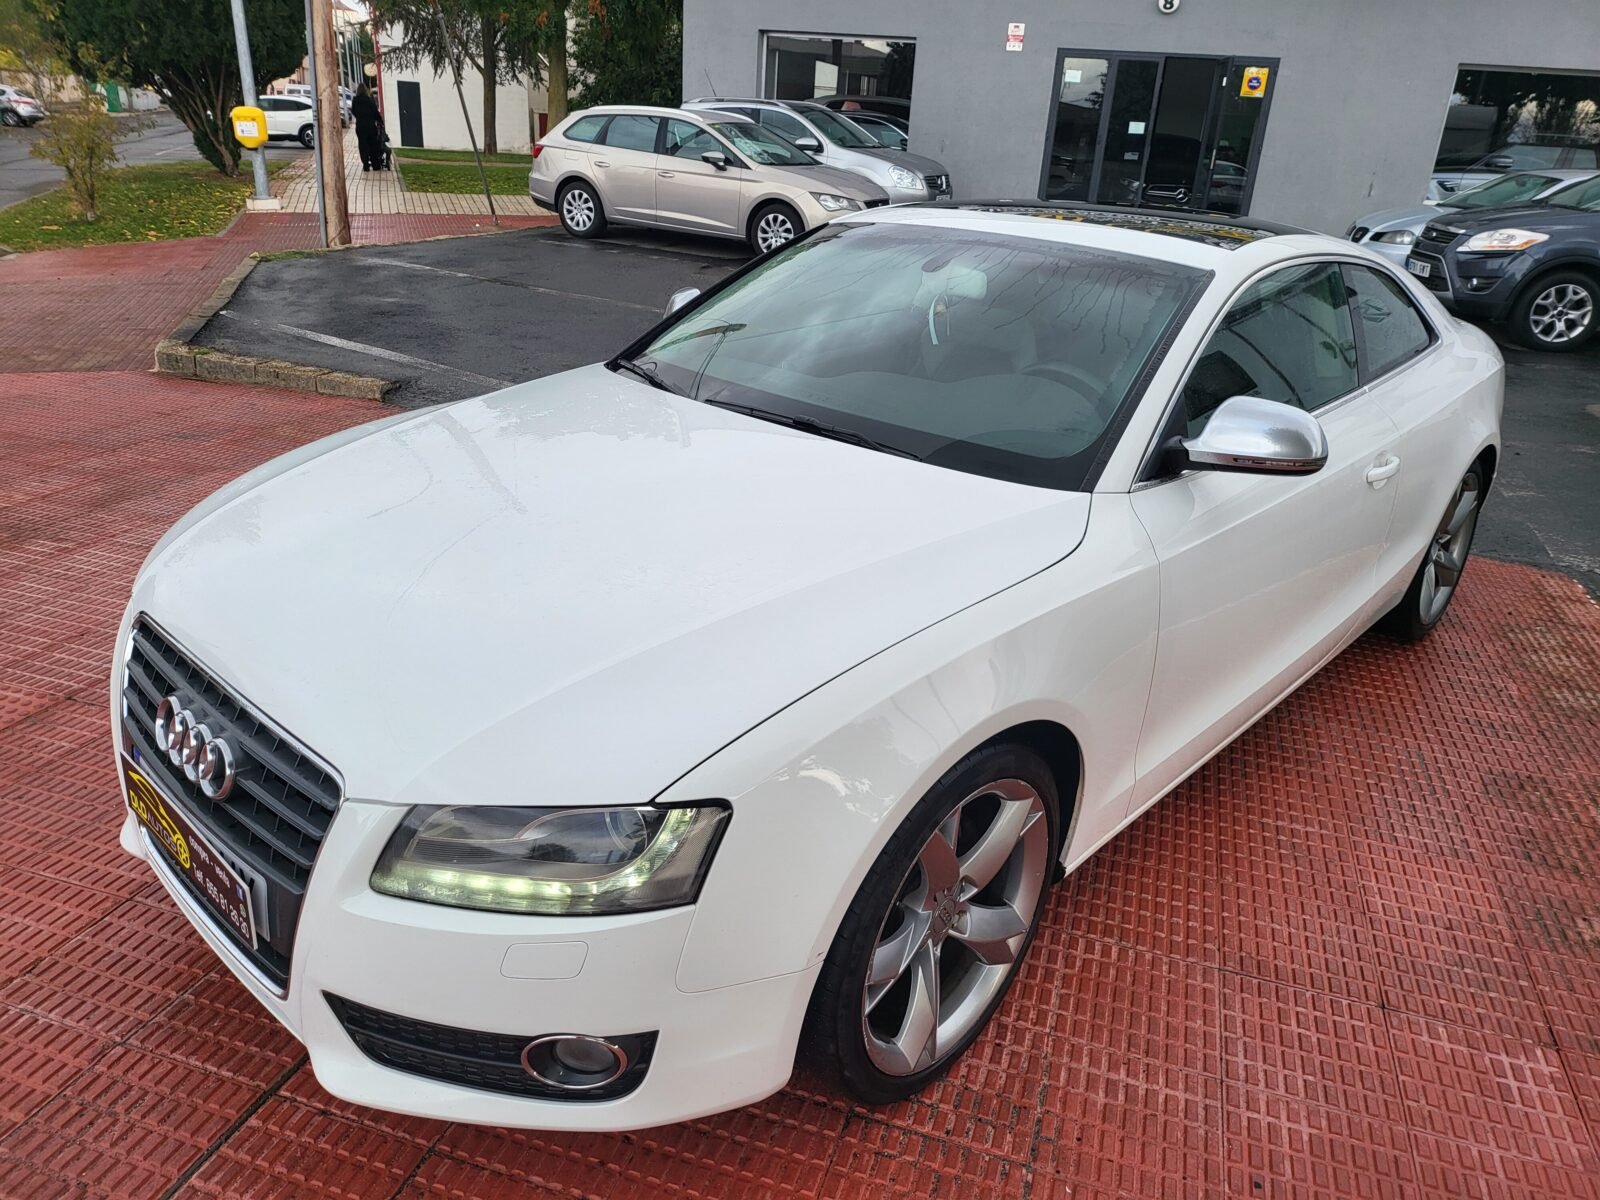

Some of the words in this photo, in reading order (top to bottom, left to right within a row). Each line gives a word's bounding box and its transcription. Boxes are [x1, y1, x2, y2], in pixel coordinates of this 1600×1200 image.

[1163, 0, 1174, 10] 8
[147, 811, 177, 851] AUTOS
[188, 835, 210, 865] compra
